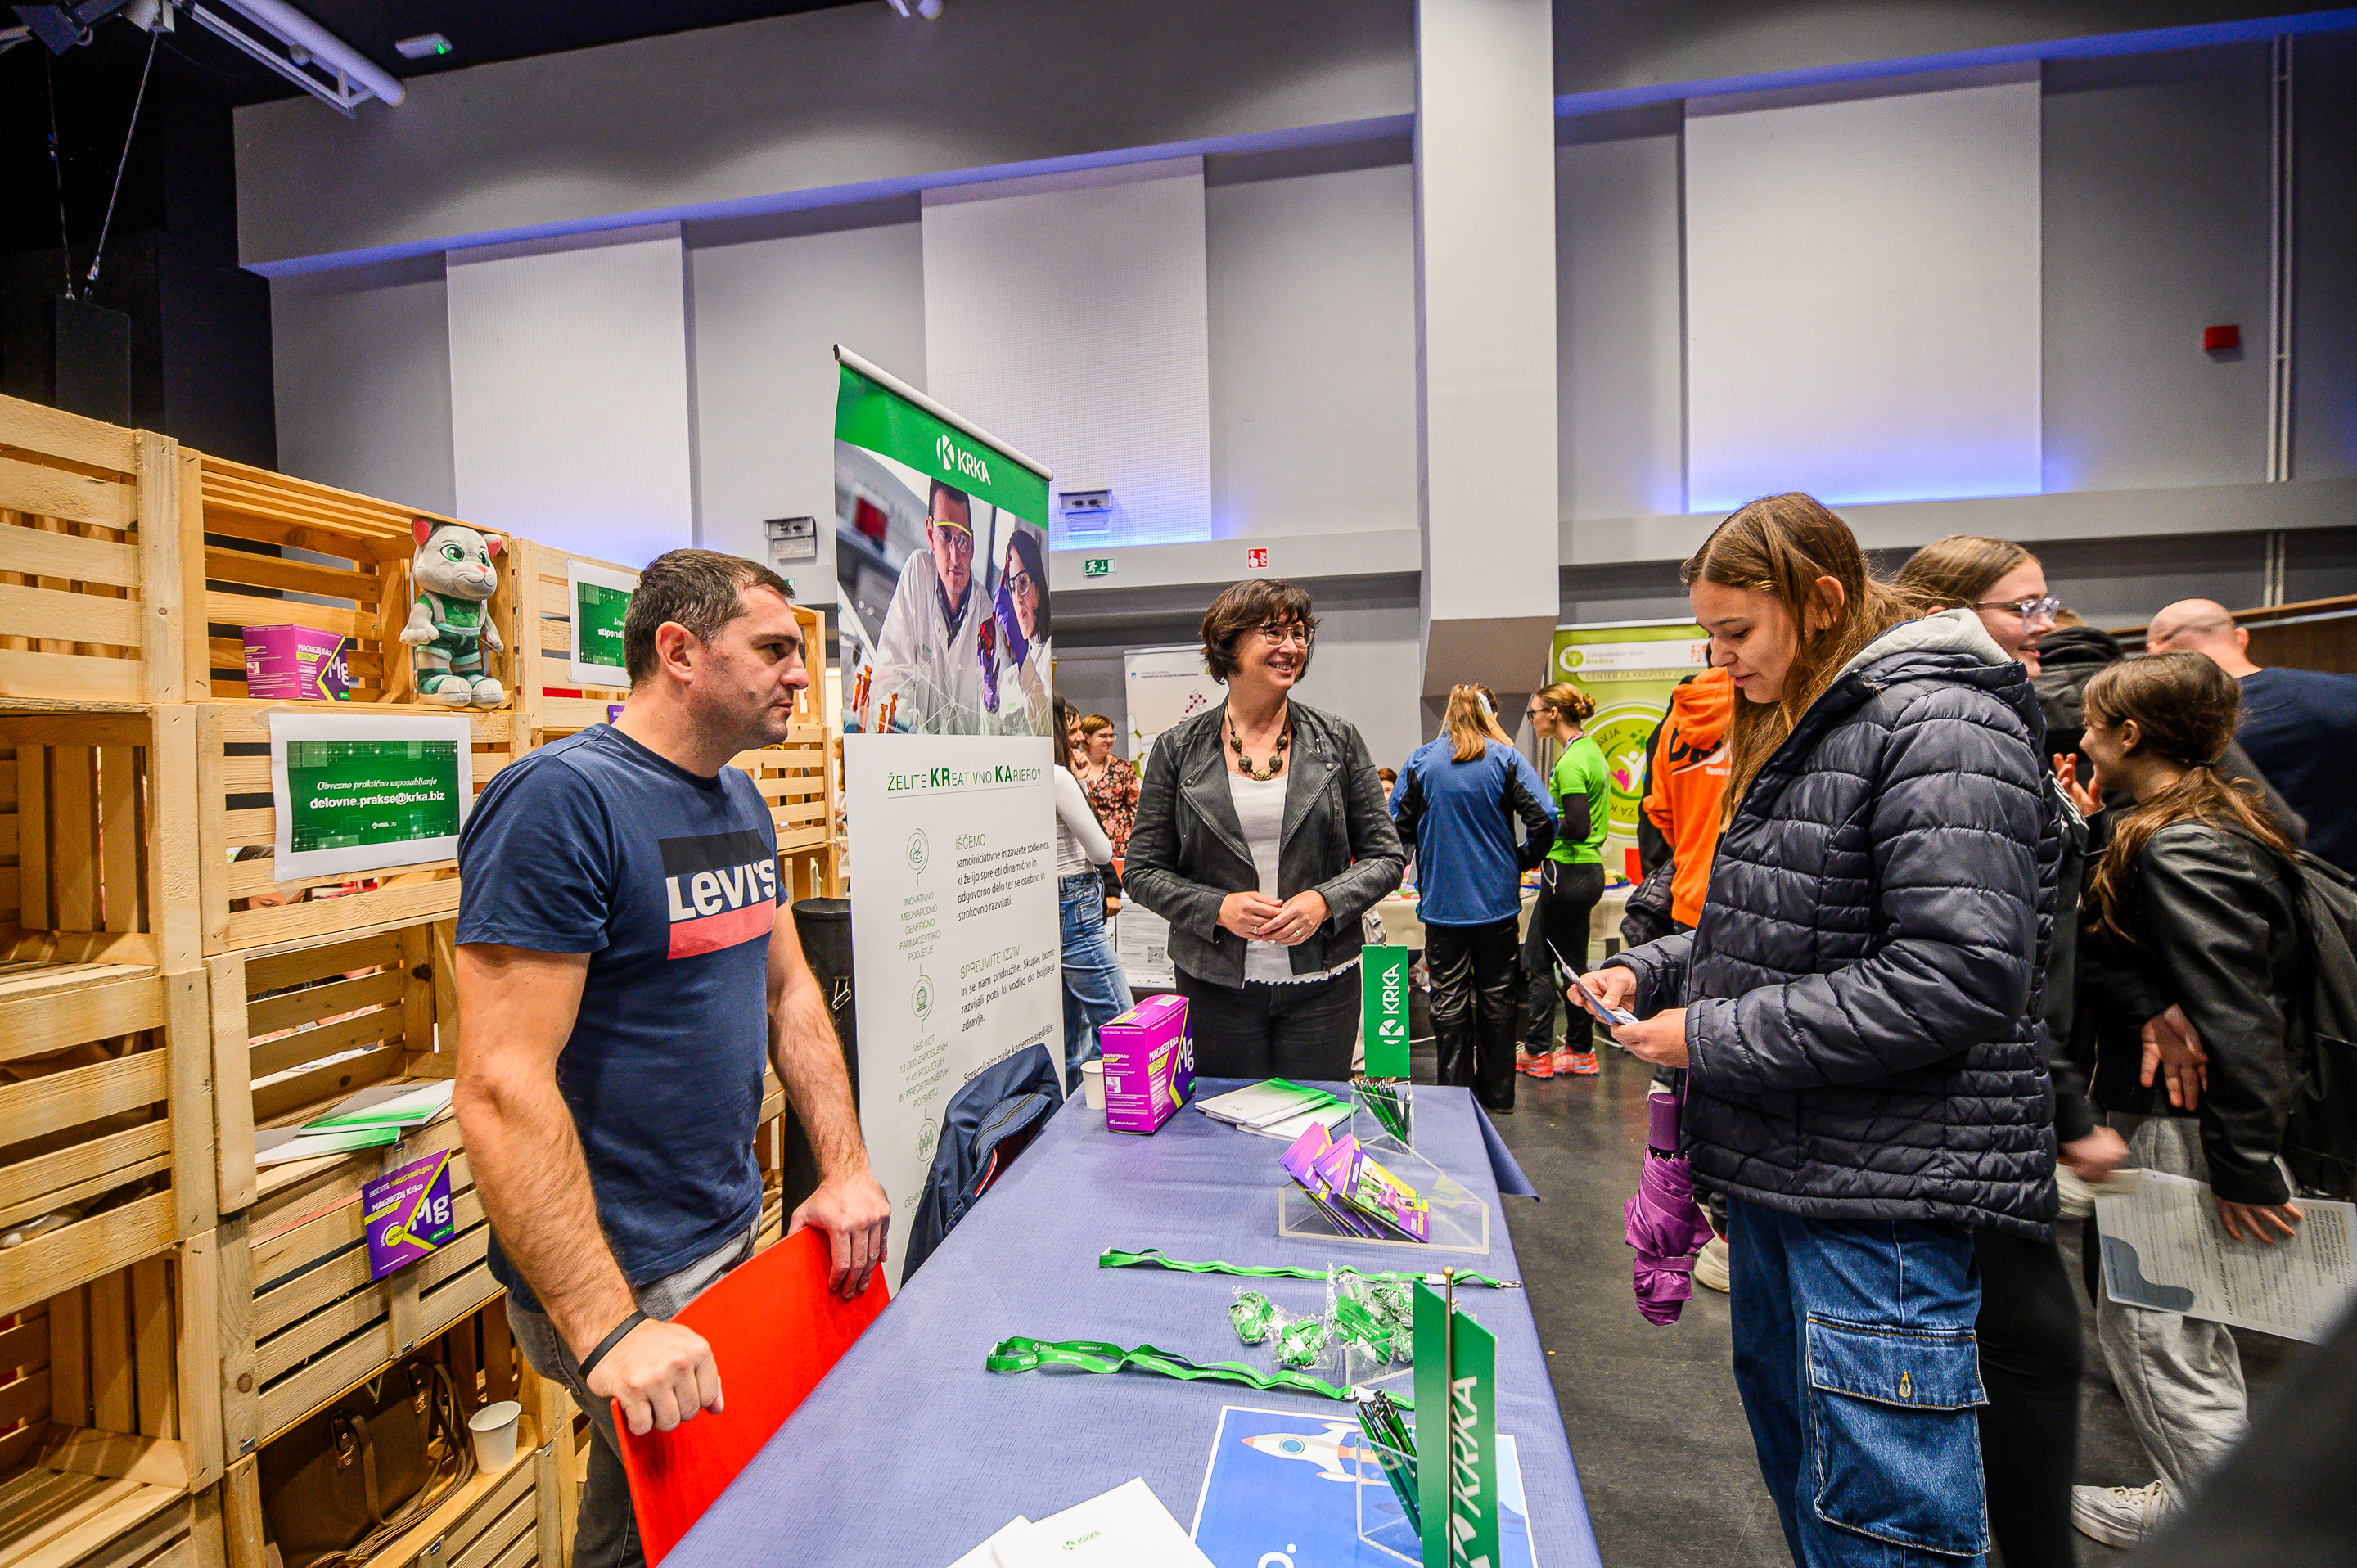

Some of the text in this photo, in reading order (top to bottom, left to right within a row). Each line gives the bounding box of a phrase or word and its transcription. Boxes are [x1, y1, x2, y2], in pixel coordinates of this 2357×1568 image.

[958, 448, 992, 486] KRKA
[317, 777, 438, 791] Obvezno praktično usposabljanje
[887, 765, 1041, 791] ŽELITE KREATIVNO KARIERO?
[309, 791, 445, 809] delovne.prakse@krka.biz
[956, 833, 986, 851] IŠČEMO
[956, 851, 1001, 869] samoiniciativne
[1001, 849, 1007, 858] in
[1007, 845, 1026, 858] zavzete
[957, 858, 1038, 886] ki želijo sprejeti dinamično in
[904, 891, 935, 907] INOVATIVNO
[958, 871, 1046, 904] odgovorno delo ter se osebno in
[900, 903, 938, 922] MEDNARODNO
[958, 896, 1013, 921] strokovno razvijati.
[904, 917, 935, 935] GENERIČNO
[899, 929, 940, 951] FARMACEVTSKO
[908, 944, 935, 962] PODJETJE
[960, 944, 1021, 980] SPREJMITE IZZIV
[960, 948, 1055, 998] in se nam pridružite. Skupaj bomo
[986, 987, 1000, 1006] poti,
[1001, 984, 1007, 995] ki
[1008, 976, 1026, 993] vodijo
[1027, 972, 1035, 983] do
[1382, 962, 1400, 1014] KRKA
[962, 1012, 985, 1033] zdravja.
[1149, 1039, 1170, 1062] MAGNEZIJ
[1178, 1036, 1195, 1075] Mg
[372, 1190, 406, 1212] MAGNEZIJ
[411, 1195, 450, 1232] Mg
[1452, 1376, 1481, 1519] KRKA
